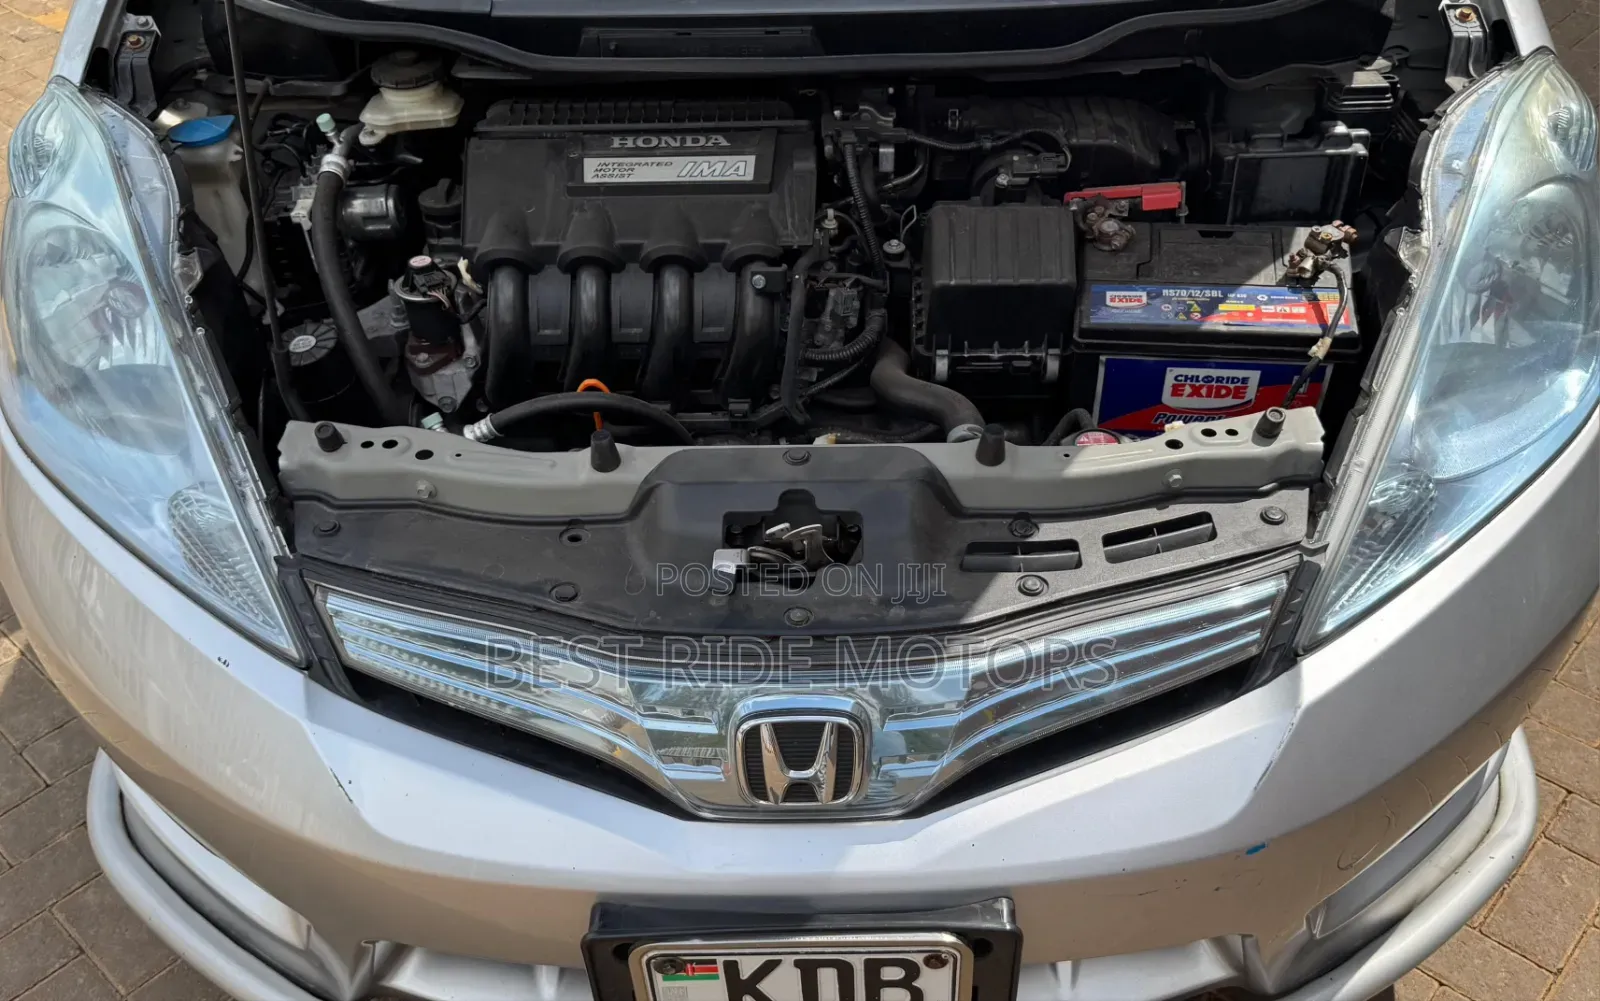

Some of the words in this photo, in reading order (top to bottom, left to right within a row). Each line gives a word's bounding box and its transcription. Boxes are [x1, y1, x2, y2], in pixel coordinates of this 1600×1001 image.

[610, 134, 730, 148] HONDA
[677, 160, 747, 178] IMA
[1173, 374, 1250, 384] CHLORIDE
[1170, 383, 1249, 400] EXIDE
[722, 958, 925, 1001] KDB
